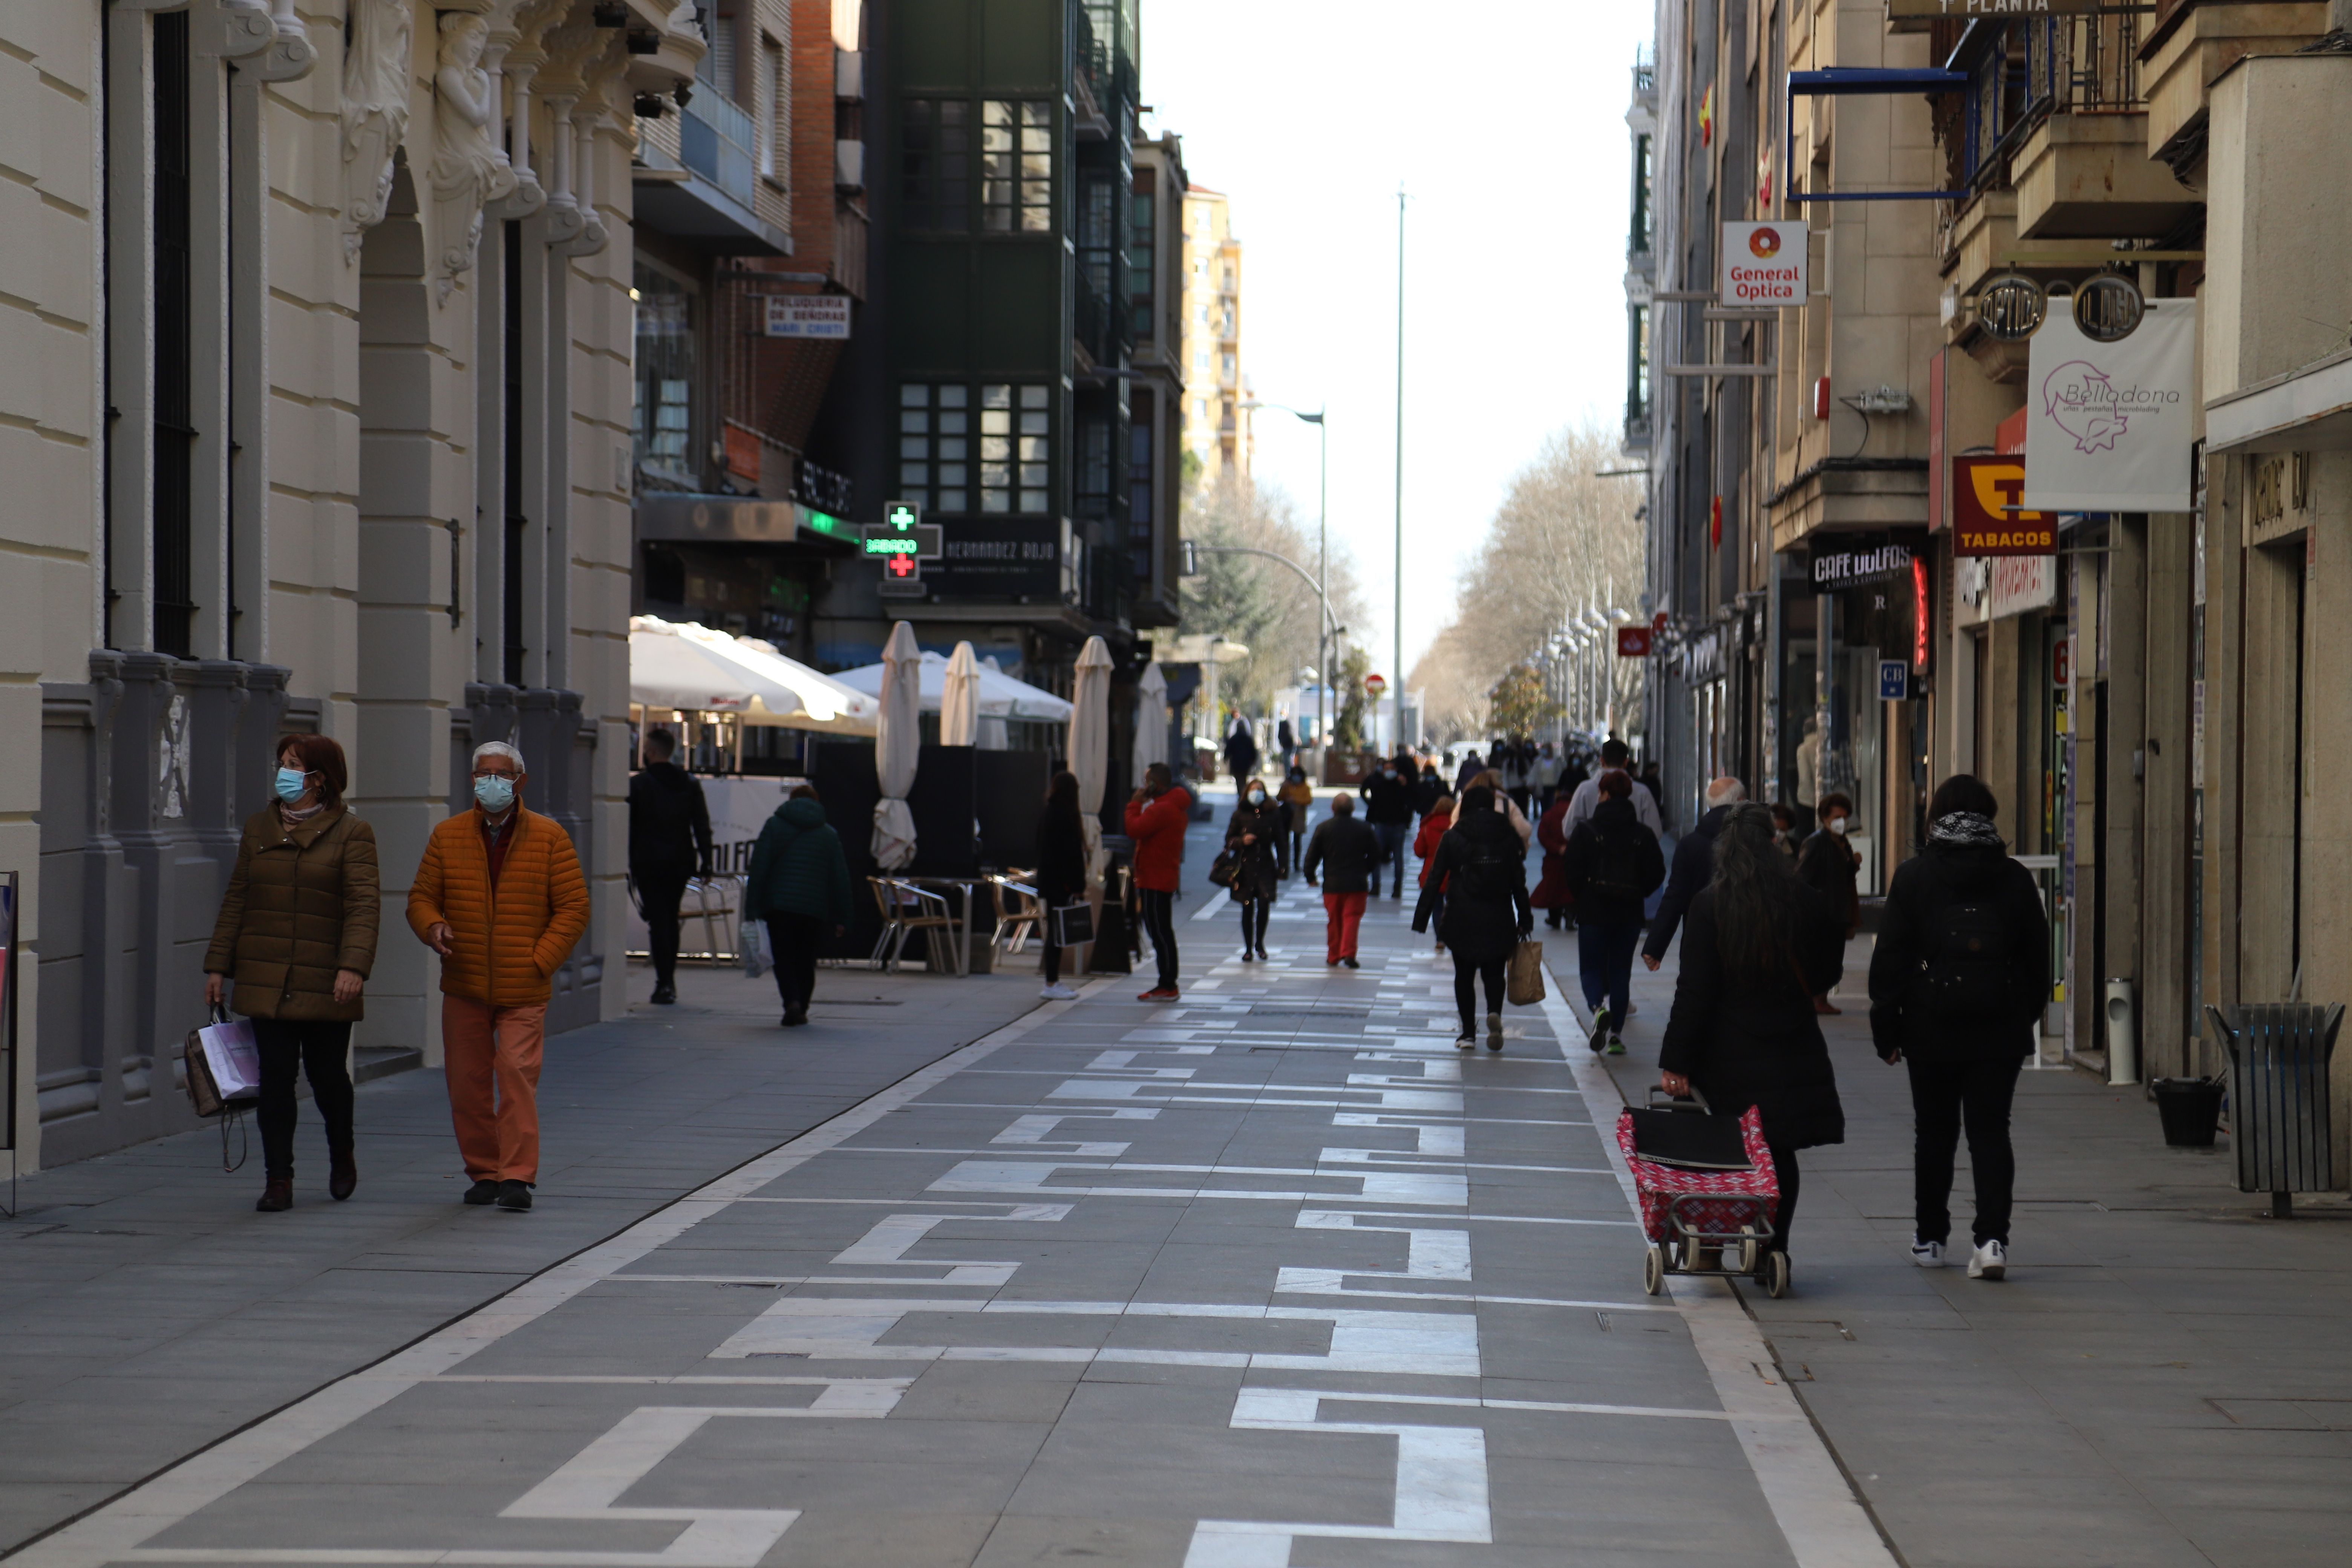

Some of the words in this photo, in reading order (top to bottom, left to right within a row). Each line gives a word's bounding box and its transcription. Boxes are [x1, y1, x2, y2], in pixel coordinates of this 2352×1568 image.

[1967, 0, 2049, 13] PLANTA
[1731, 265, 1799, 281] General
[1736, 283, 1793, 301] Optica
[2066, 384, 2180, 403] Belladona
[2083, 406, 2113, 414] pestañas
[2117, 405, 2160, 414] microblading
[1961, 531, 2051, 548] TABACOS
[1022, 541, 1054, 559] ROJO
[1815, 552, 1851, 582] CAFE
[1874, 594, 1886, 611] R
[1883, 667, 1903, 682] CB
